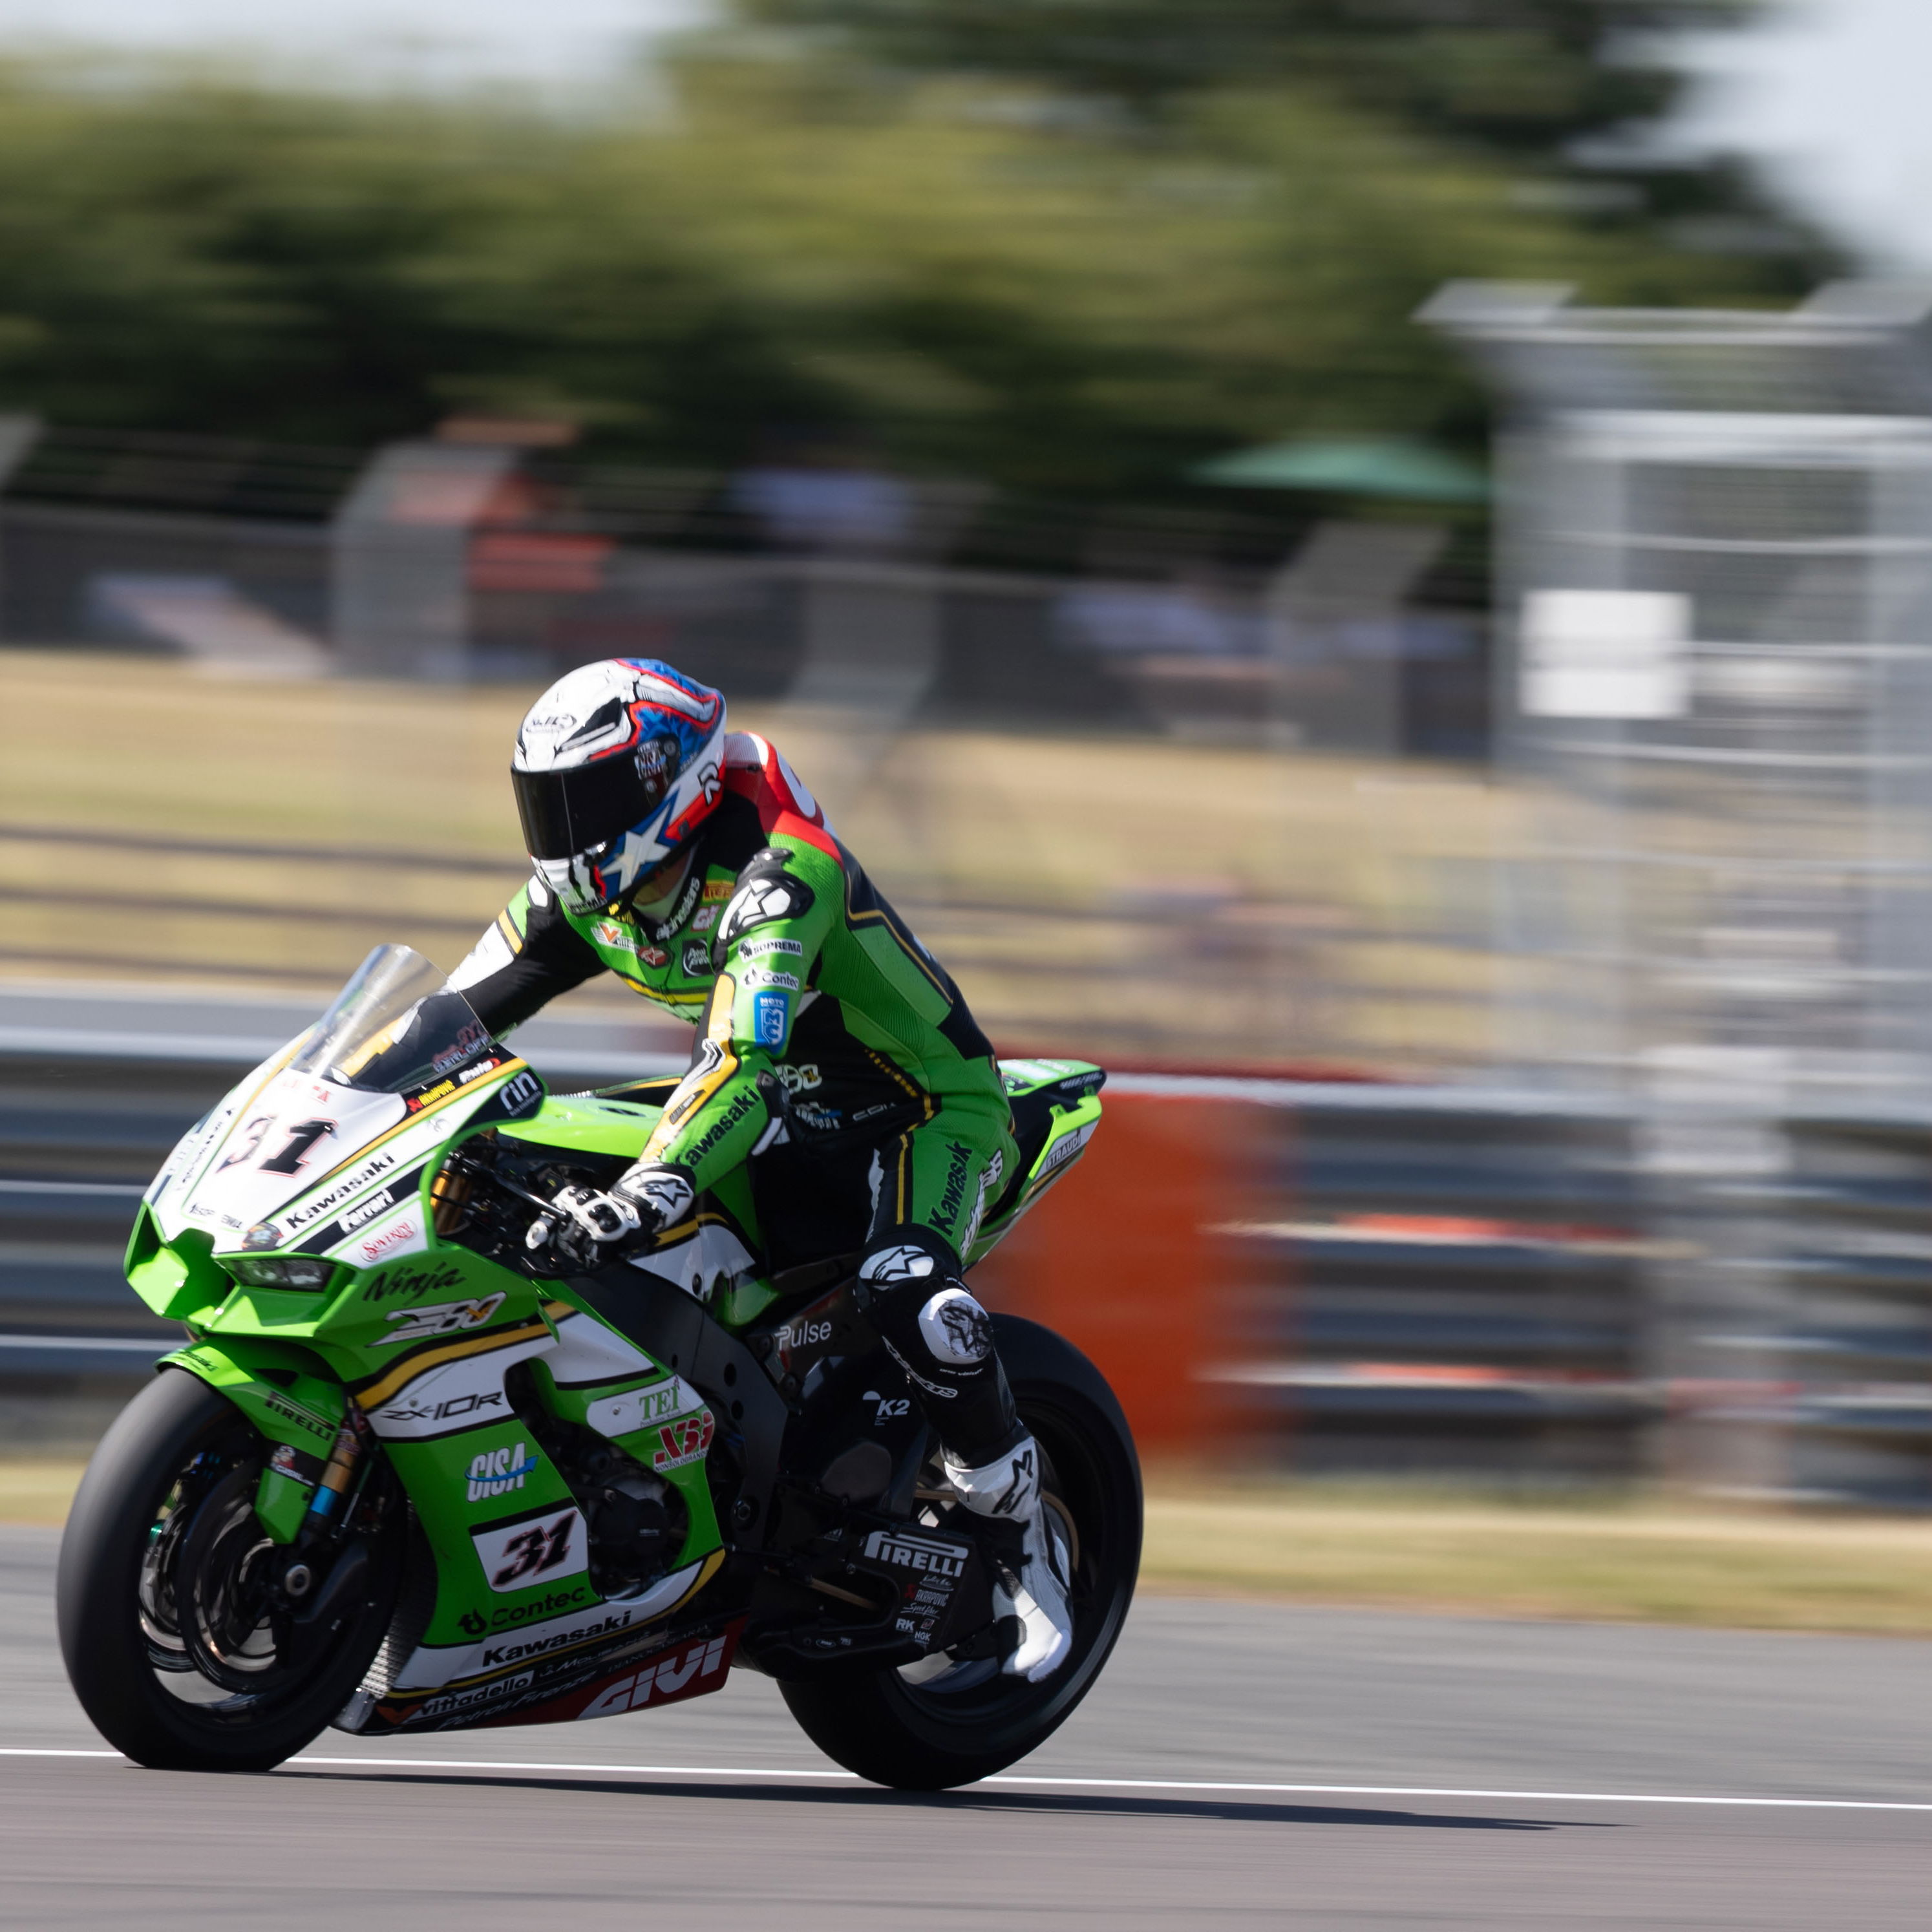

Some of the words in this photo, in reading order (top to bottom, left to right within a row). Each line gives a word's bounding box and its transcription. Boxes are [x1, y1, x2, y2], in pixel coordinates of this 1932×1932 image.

[753, 940, 801, 954] SOPREMA
[285, 1152, 396, 1229] Kawasaki
[362, 1262, 468, 1306] Ninja
[774, 1321, 832, 1350] Pulse
[264, 1390, 337, 1441] PIRELLI
[876, 1399, 910, 1416] K2
[492, 1510, 579, 1589] 31
[864, 1531, 969, 1578] PIRELLI
[491, 1587, 586, 1627] Contec
[896, 1618, 915, 1632] RK
[482, 1610, 632, 1668] Kawasaki
[915, 1631, 931, 1641] NGK
